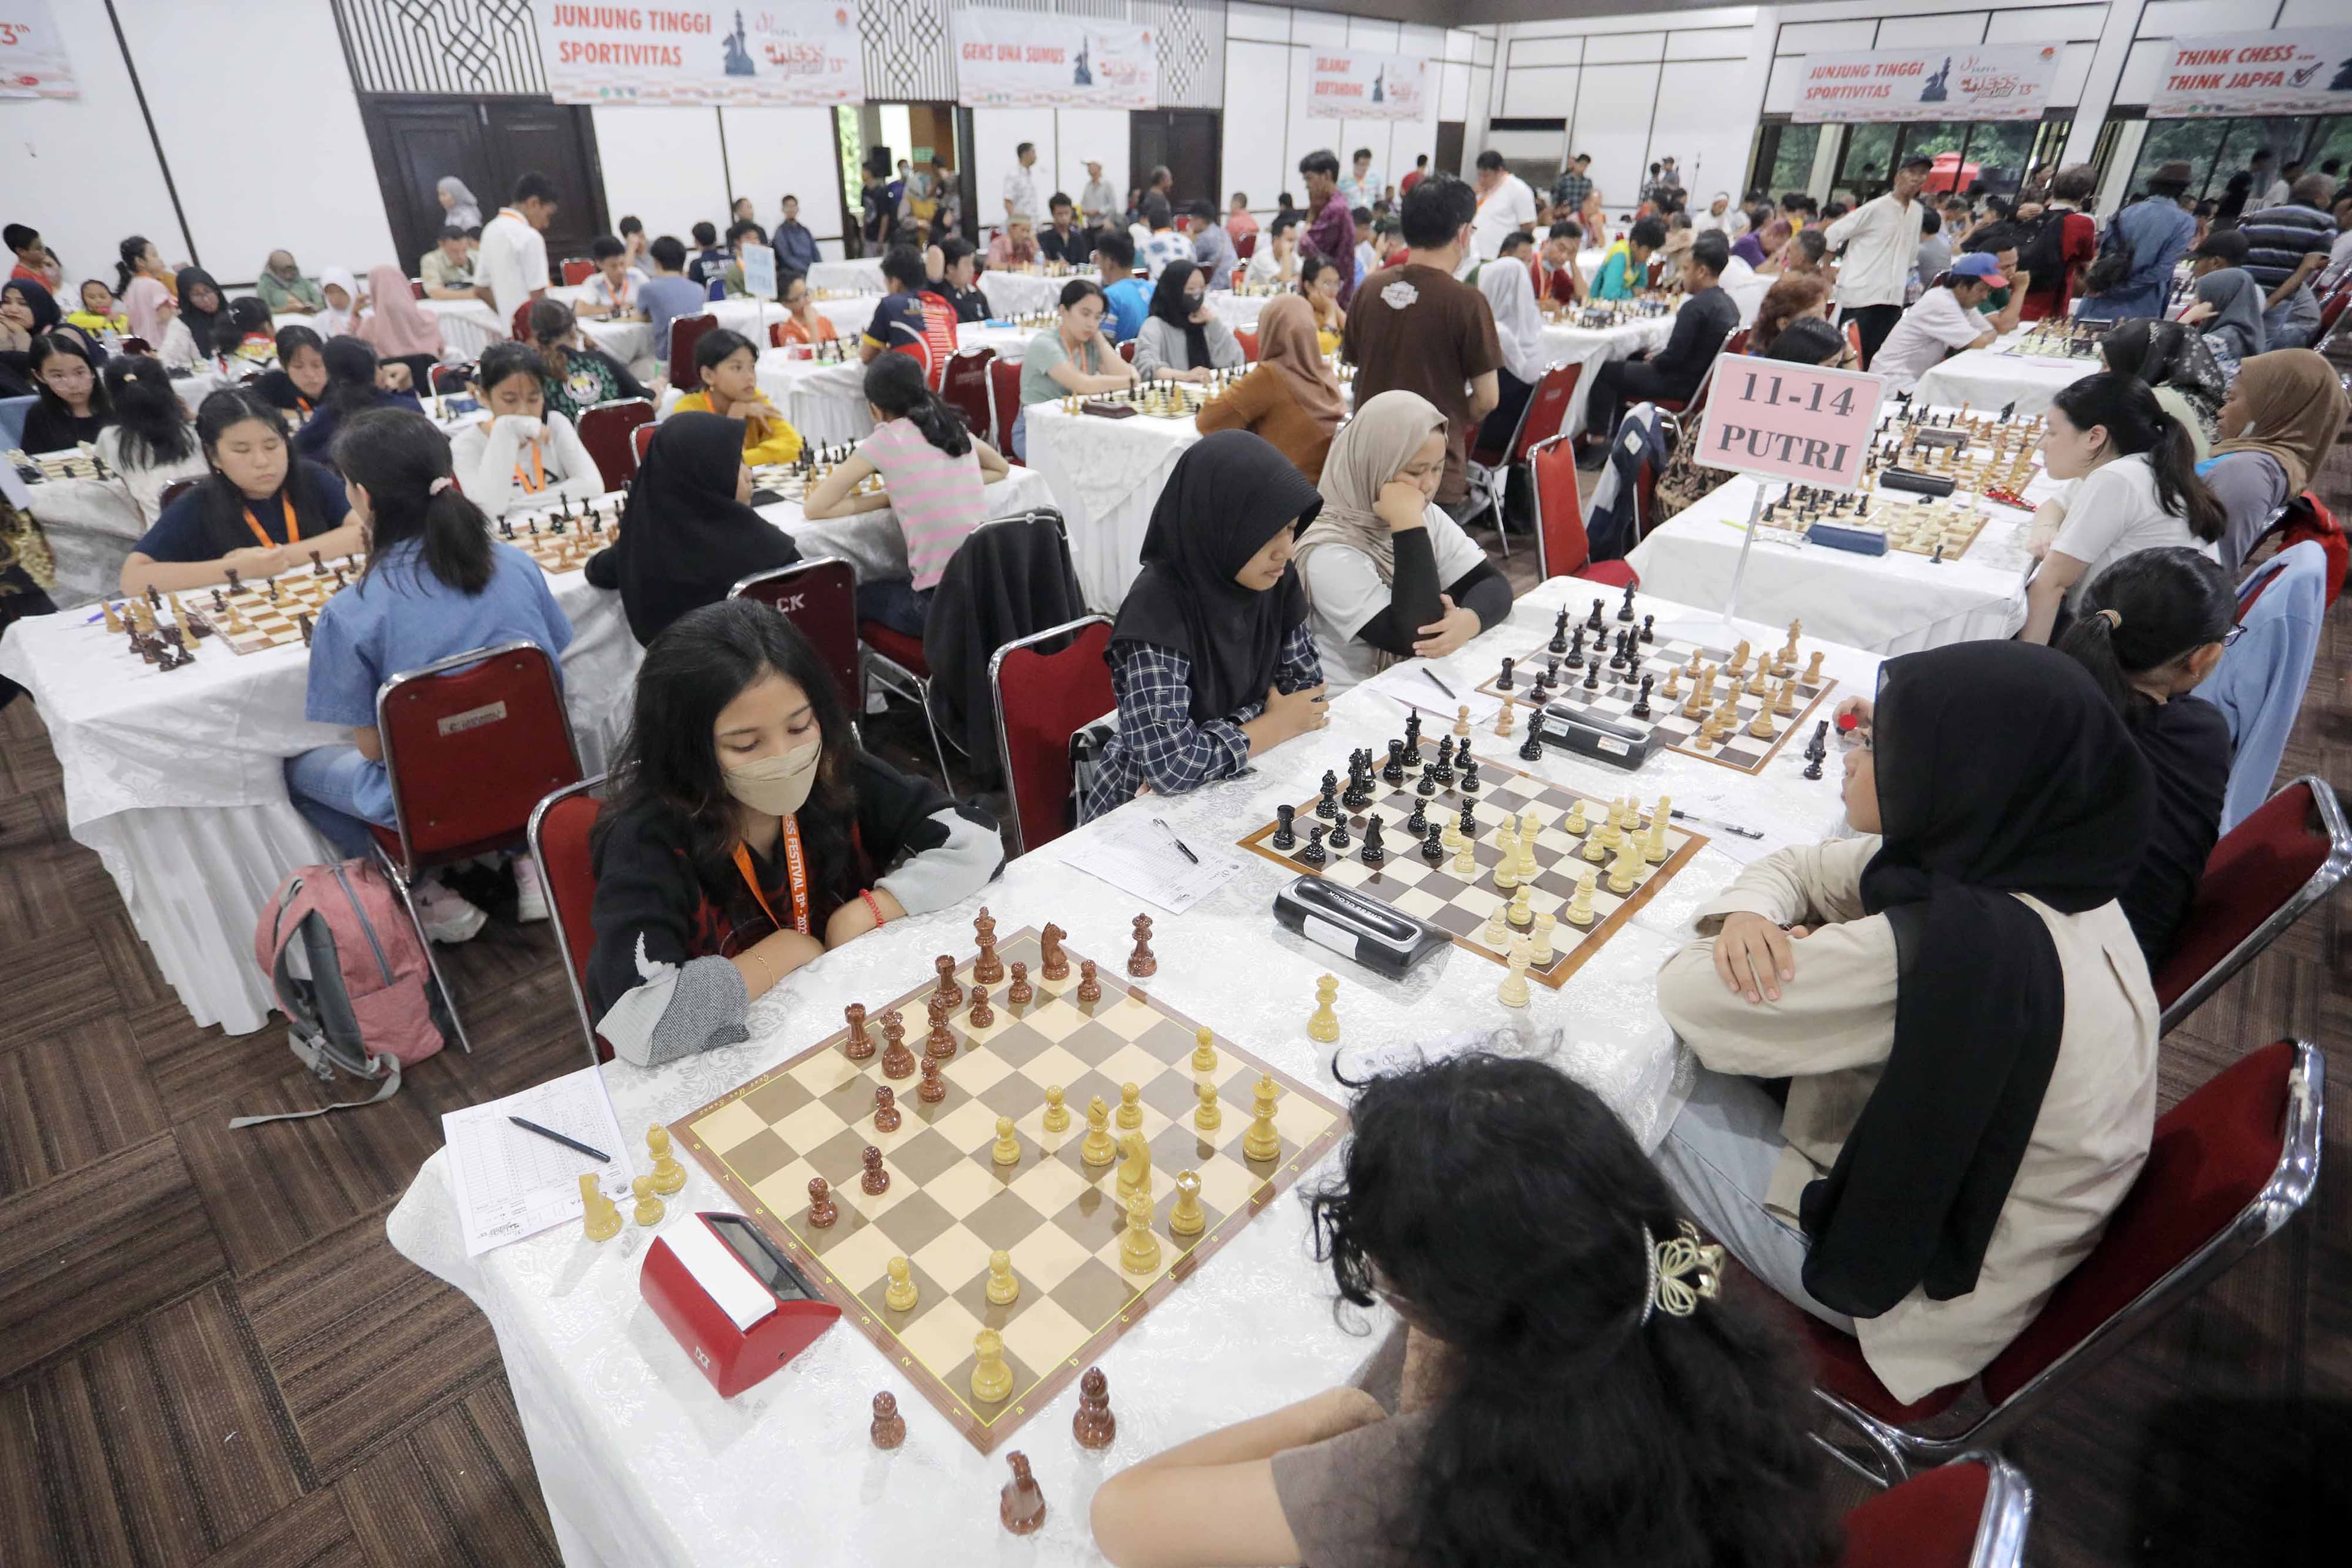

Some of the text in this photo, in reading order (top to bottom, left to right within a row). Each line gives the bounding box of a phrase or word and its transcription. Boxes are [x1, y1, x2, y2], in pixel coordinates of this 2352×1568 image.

[553, 4, 711, 34] JUNJUNG TINGGI
[559, 40, 682, 66] SPORTIVITAS
[2175, 48, 2234, 66] THINK
[2237, 45, 2296, 63] CHESS
[1809, 62, 1924, 79] JUNJUNG TINGGI
[2166, 71, 2285, 90] THINK JAPFA
[1806, 85, 1891, 100] SPORTIVITAS
[1739, 372, 1855, 417] 11-14
[1717, 423, 1850, 472] PUTRI
[776, 593, 805, 612] CK
[788, 838, 804, 891] FESTIVAL
[795, 892, 805, 908] 13th
[1328, 891, 1355, 907] CLOCK
[694, 1345, 710, 1370] DGT
[902, 1357, 911, 1366] 2
